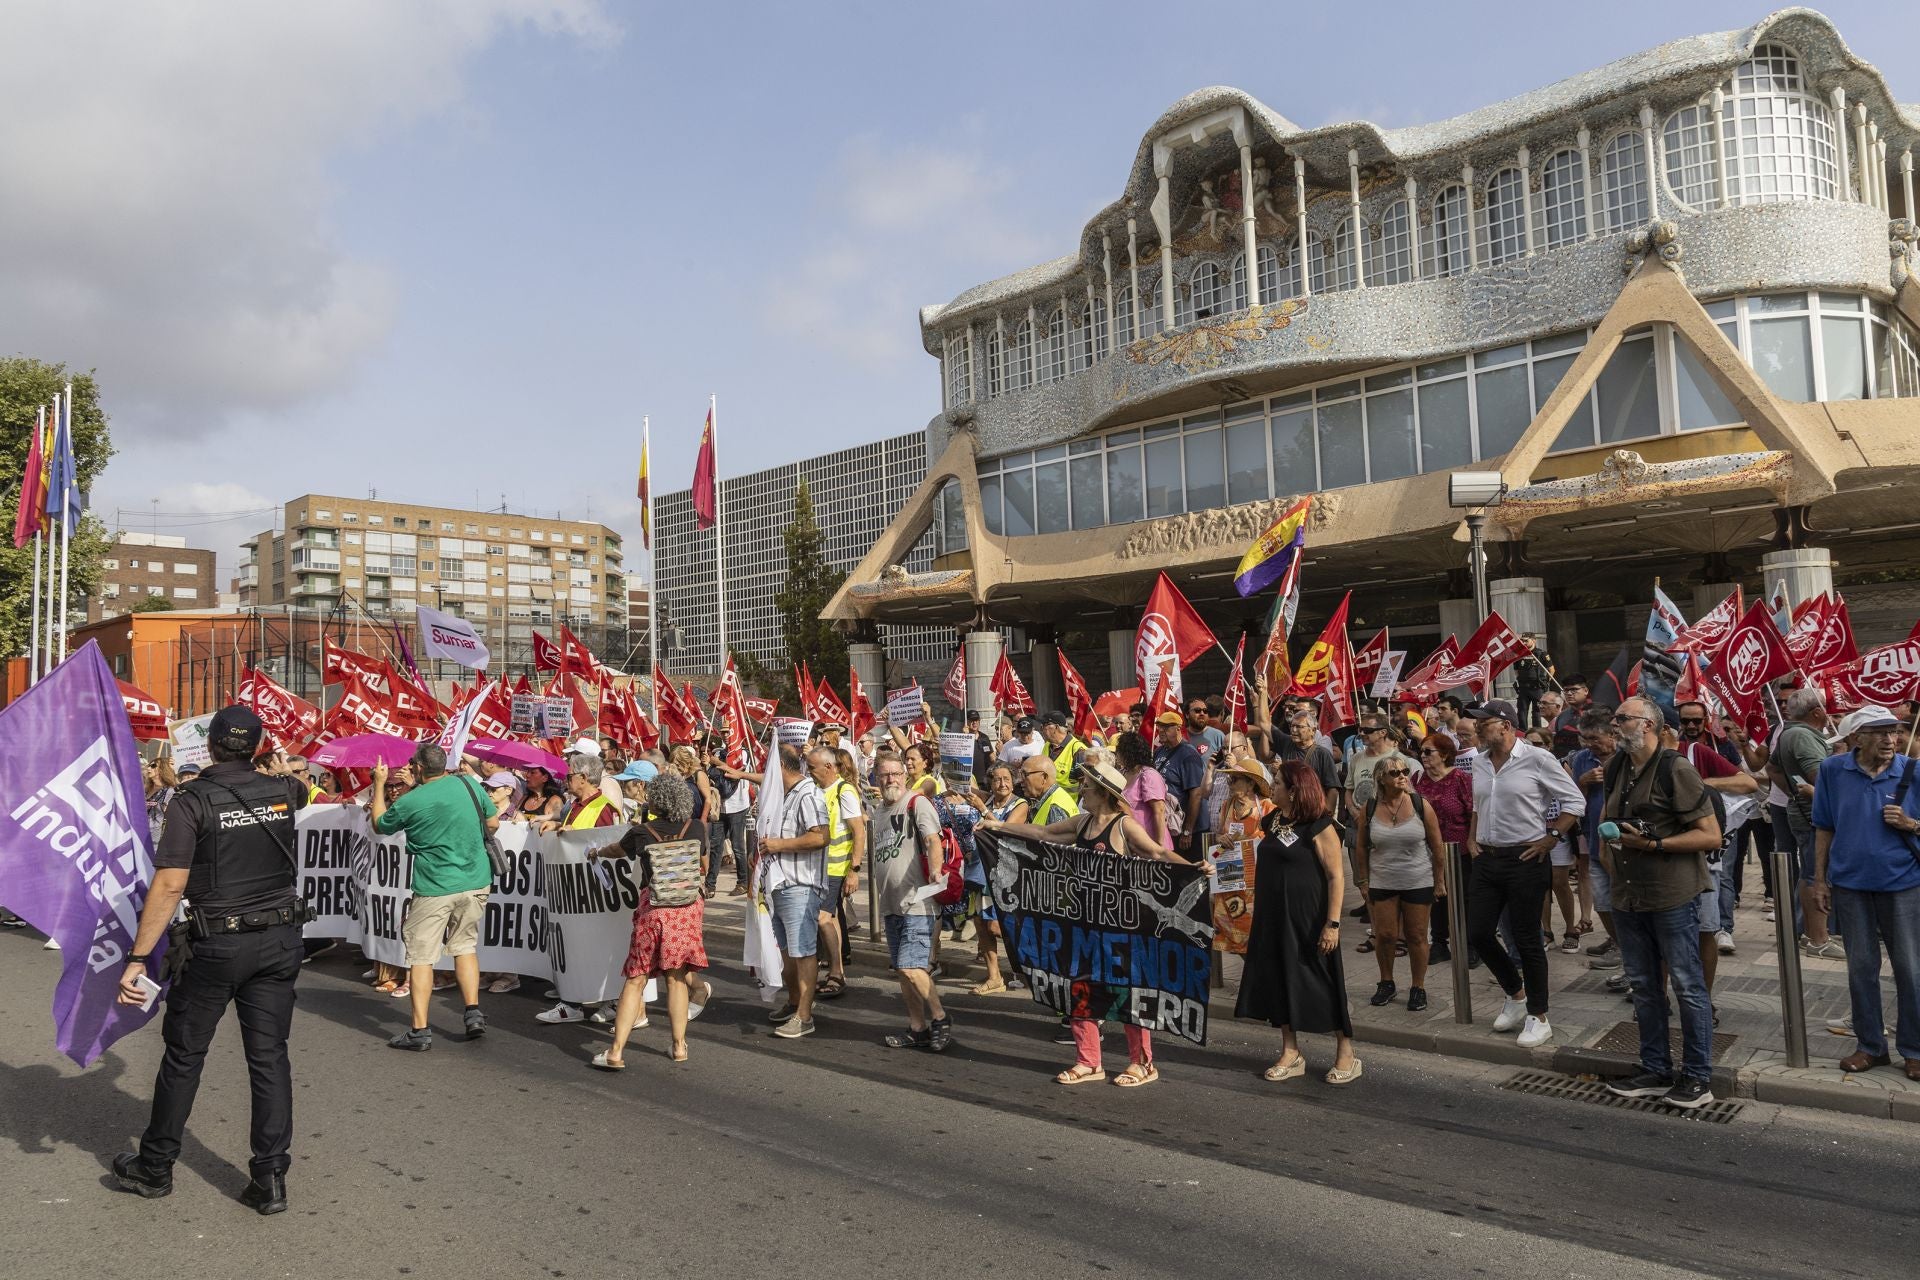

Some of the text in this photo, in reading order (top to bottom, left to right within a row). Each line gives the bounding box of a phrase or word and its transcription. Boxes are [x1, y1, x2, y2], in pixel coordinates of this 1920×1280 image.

[432, 628, 476, 650] Sumar
[230, 727, 248, 735] CNP
[472, 712, 520, 742] COO
[546, 858, 640, 915] HUMANOS
[1042, 843, 1172, 896] SALVEMOS
[371, 893, 398, 941] DEL
[484, 902, 524, 949] DEL
[1021, 868, 1141, 930] NUESTRO
[1069, 926, 1212, 1005] MENOR
